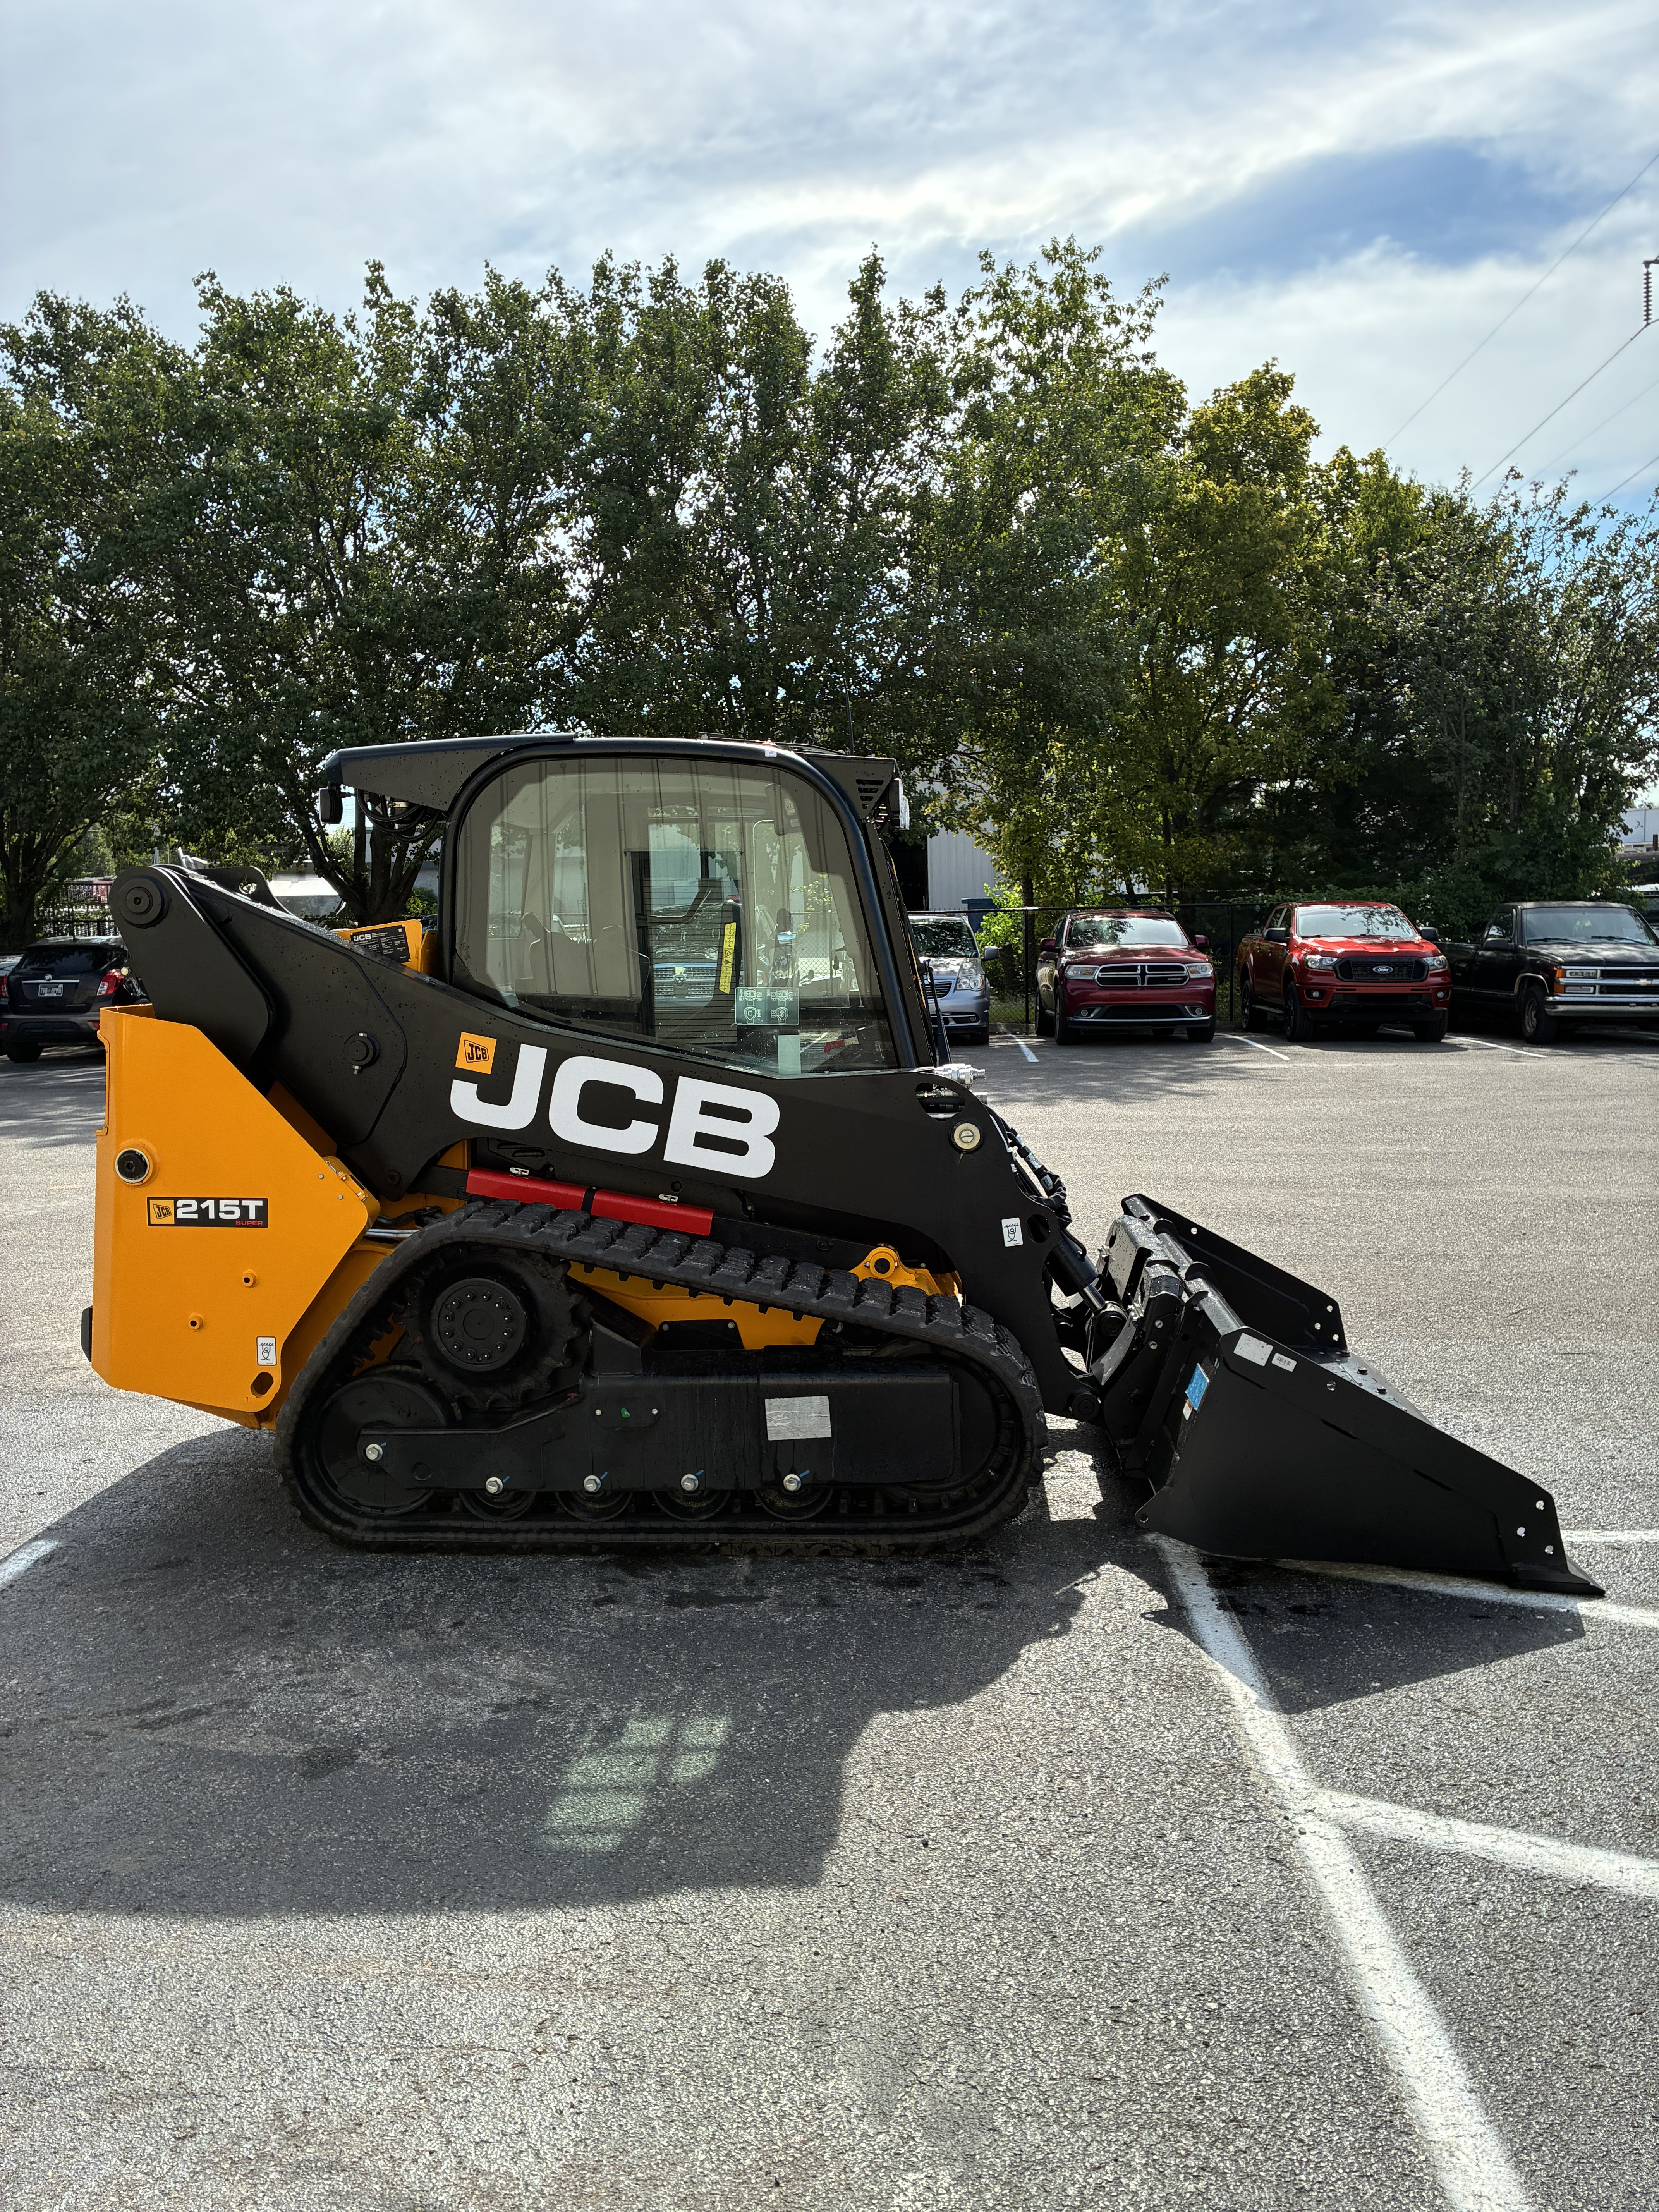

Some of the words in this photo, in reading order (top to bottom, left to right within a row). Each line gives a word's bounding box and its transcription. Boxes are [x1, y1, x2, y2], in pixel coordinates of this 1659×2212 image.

[467, 1043, 487, 1060] JCB
[450, 1043, 780, 1178] JCB
[156, 1206, 170, 1218] JCB
[176, 1199, 263, 1219] 215T
